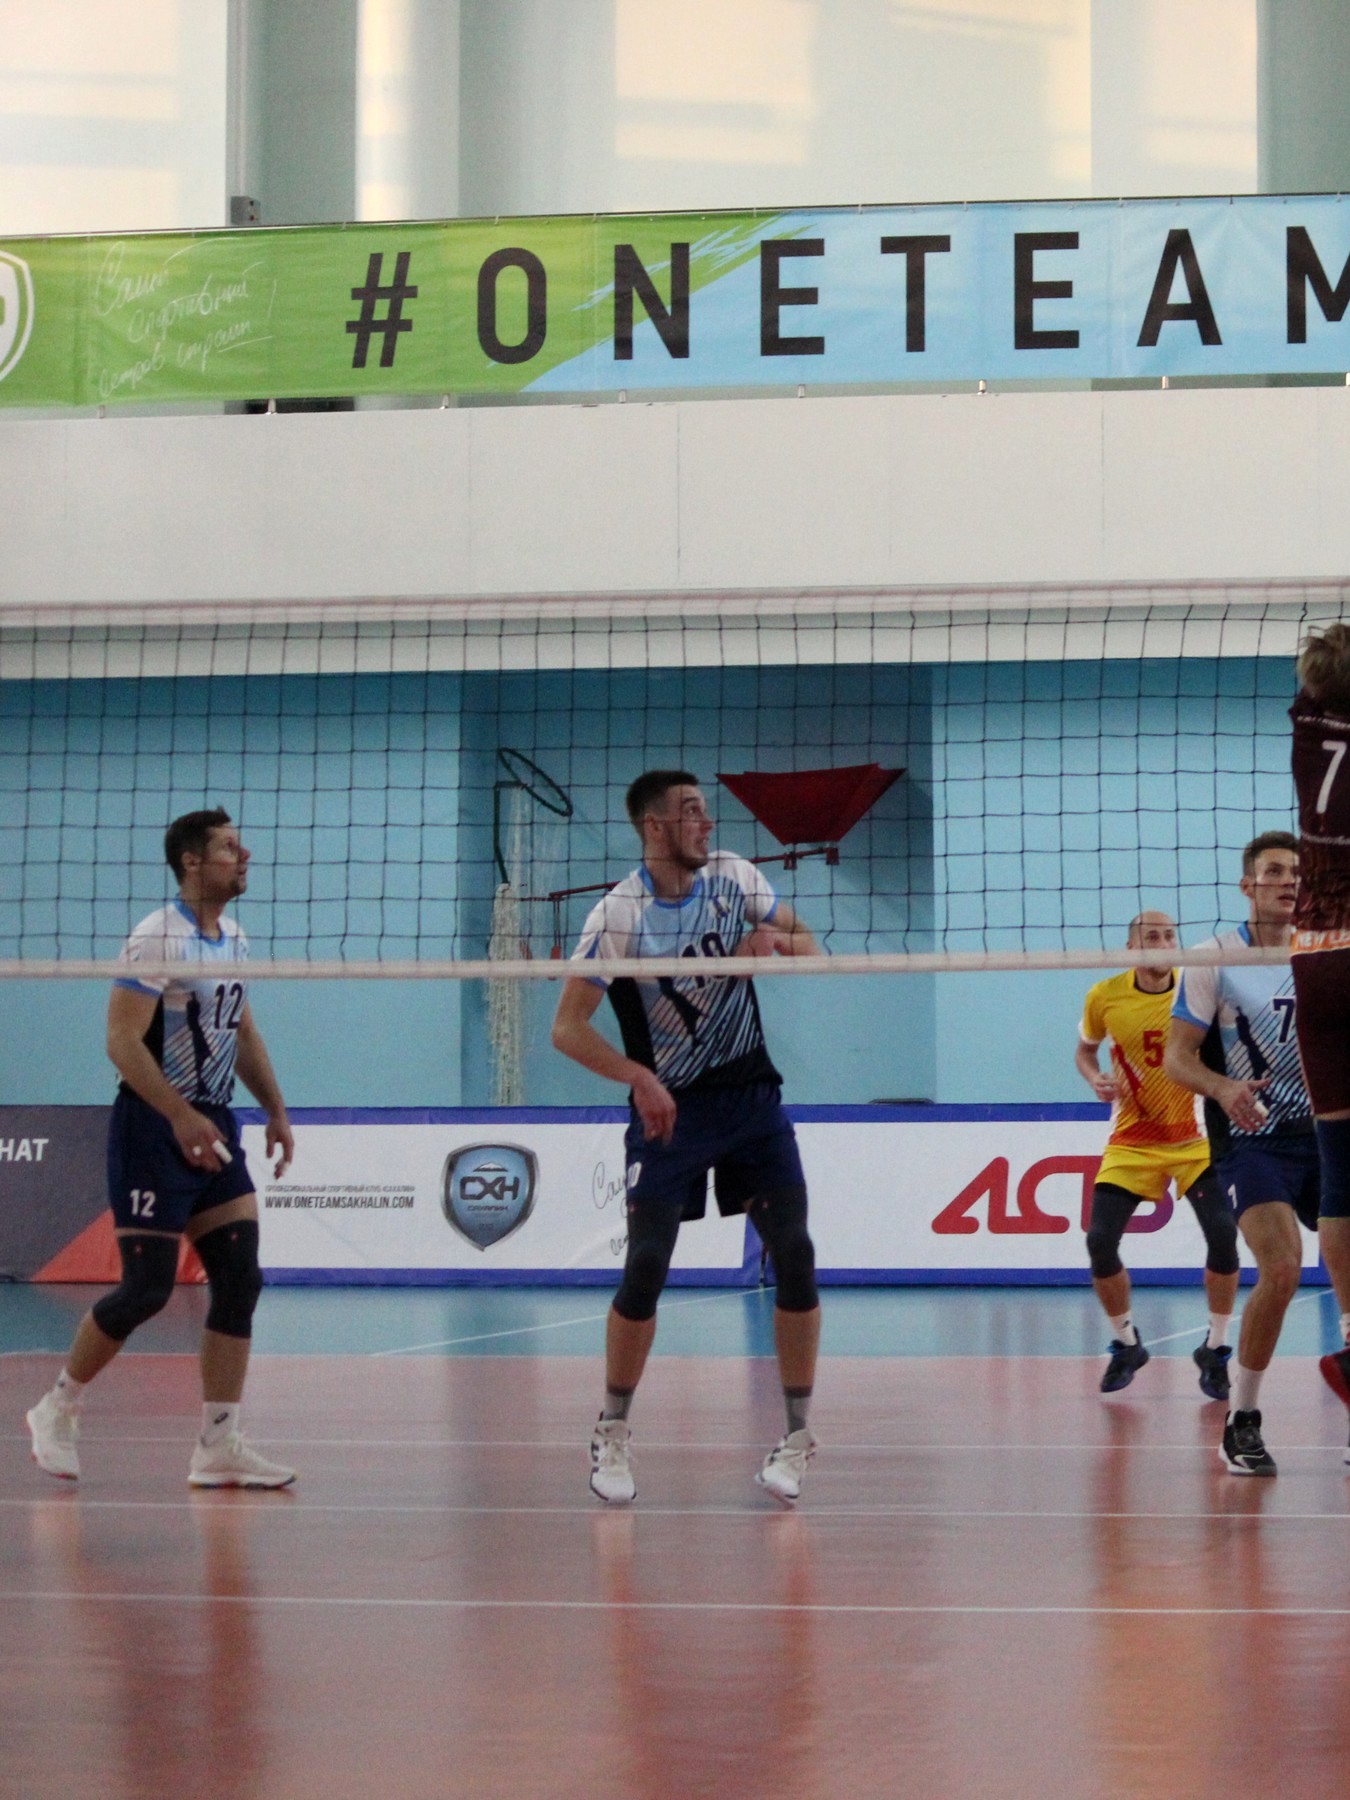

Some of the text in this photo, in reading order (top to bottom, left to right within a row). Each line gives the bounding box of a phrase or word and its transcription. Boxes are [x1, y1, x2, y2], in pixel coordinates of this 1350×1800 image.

[1316, 739, 1348, 815] 7
[213, 982, 244, 1030] 12
[1272, 998, 1295, 1044] 7
[1142, 1030, 1164, 1069] 5
[130, 1188, 156, 1218] 12
[264, 1195, 415, 1209] WWW.ONETEAMSAKHALIN.COM
